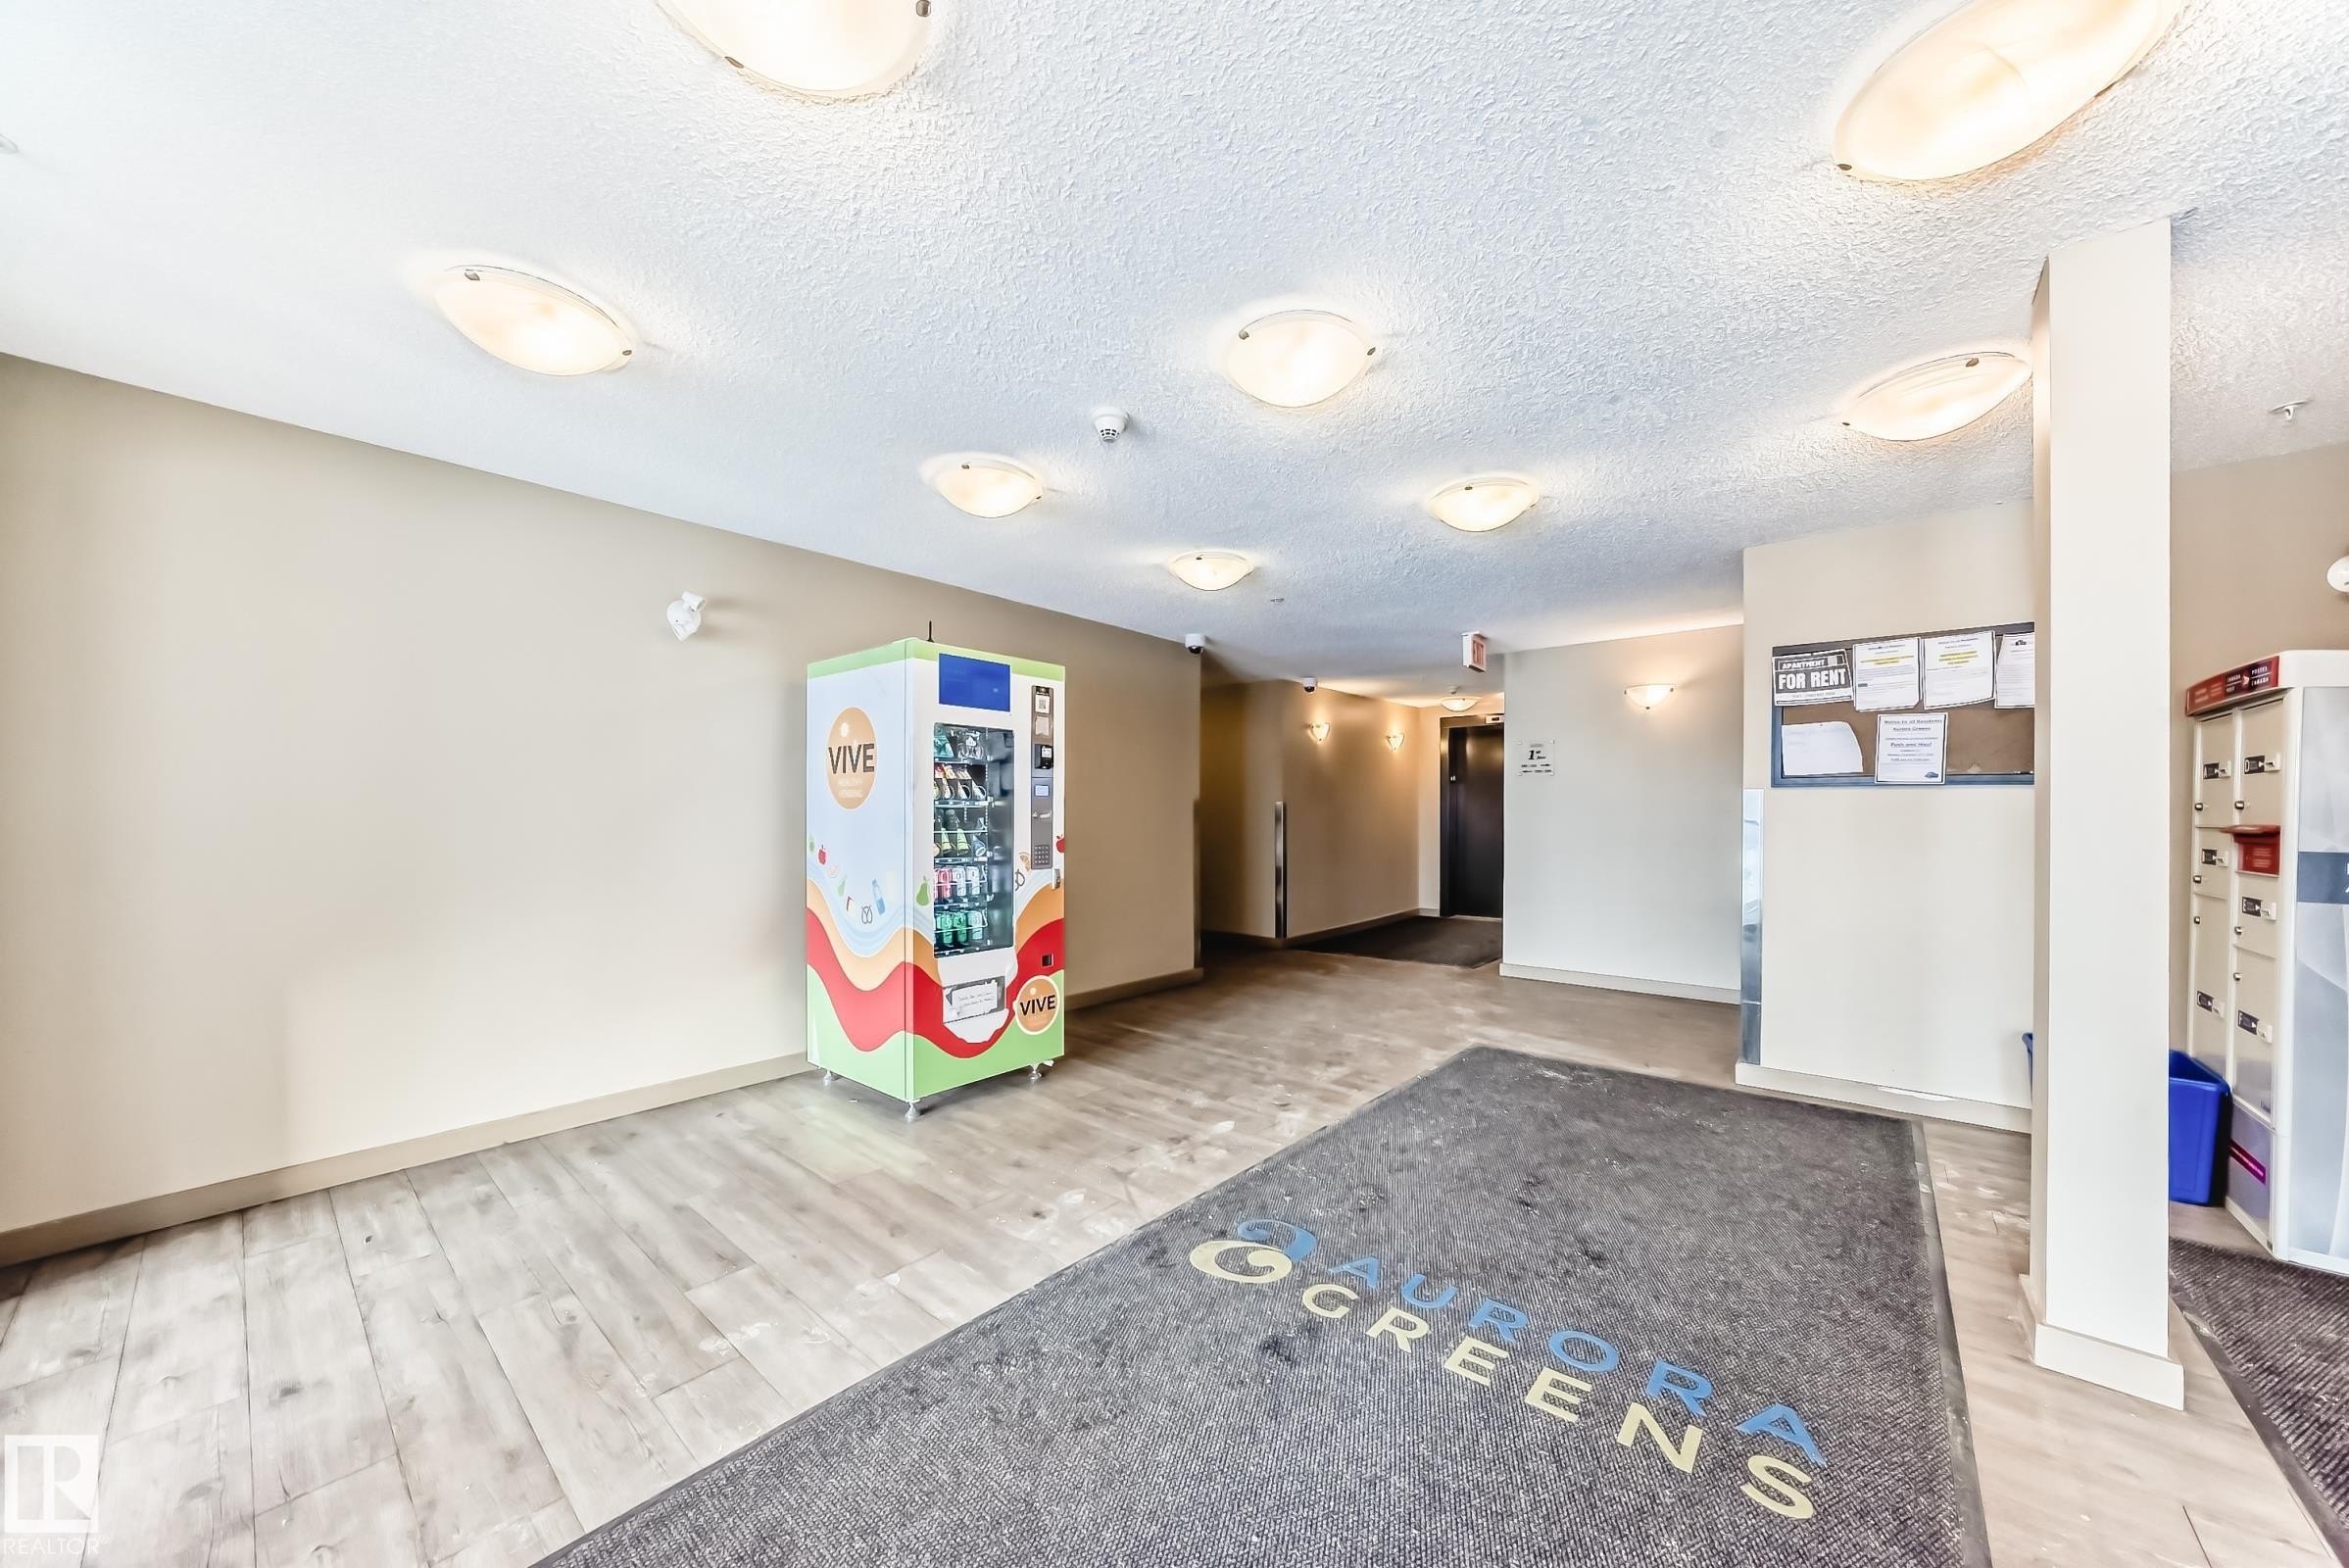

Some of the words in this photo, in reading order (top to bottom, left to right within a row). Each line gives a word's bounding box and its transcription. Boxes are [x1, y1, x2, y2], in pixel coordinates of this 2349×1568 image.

[1778, 672, 1806, 690] FOR
[1810, 667, 1846, 688] RENT
[828, 743, 875, 774] VIVE
[1019, 995, 1055, 1016] VIVE
[1328, 1255, 1828, 1468] AURORA
[1301, 1283, 1815, 1520] GREENS
